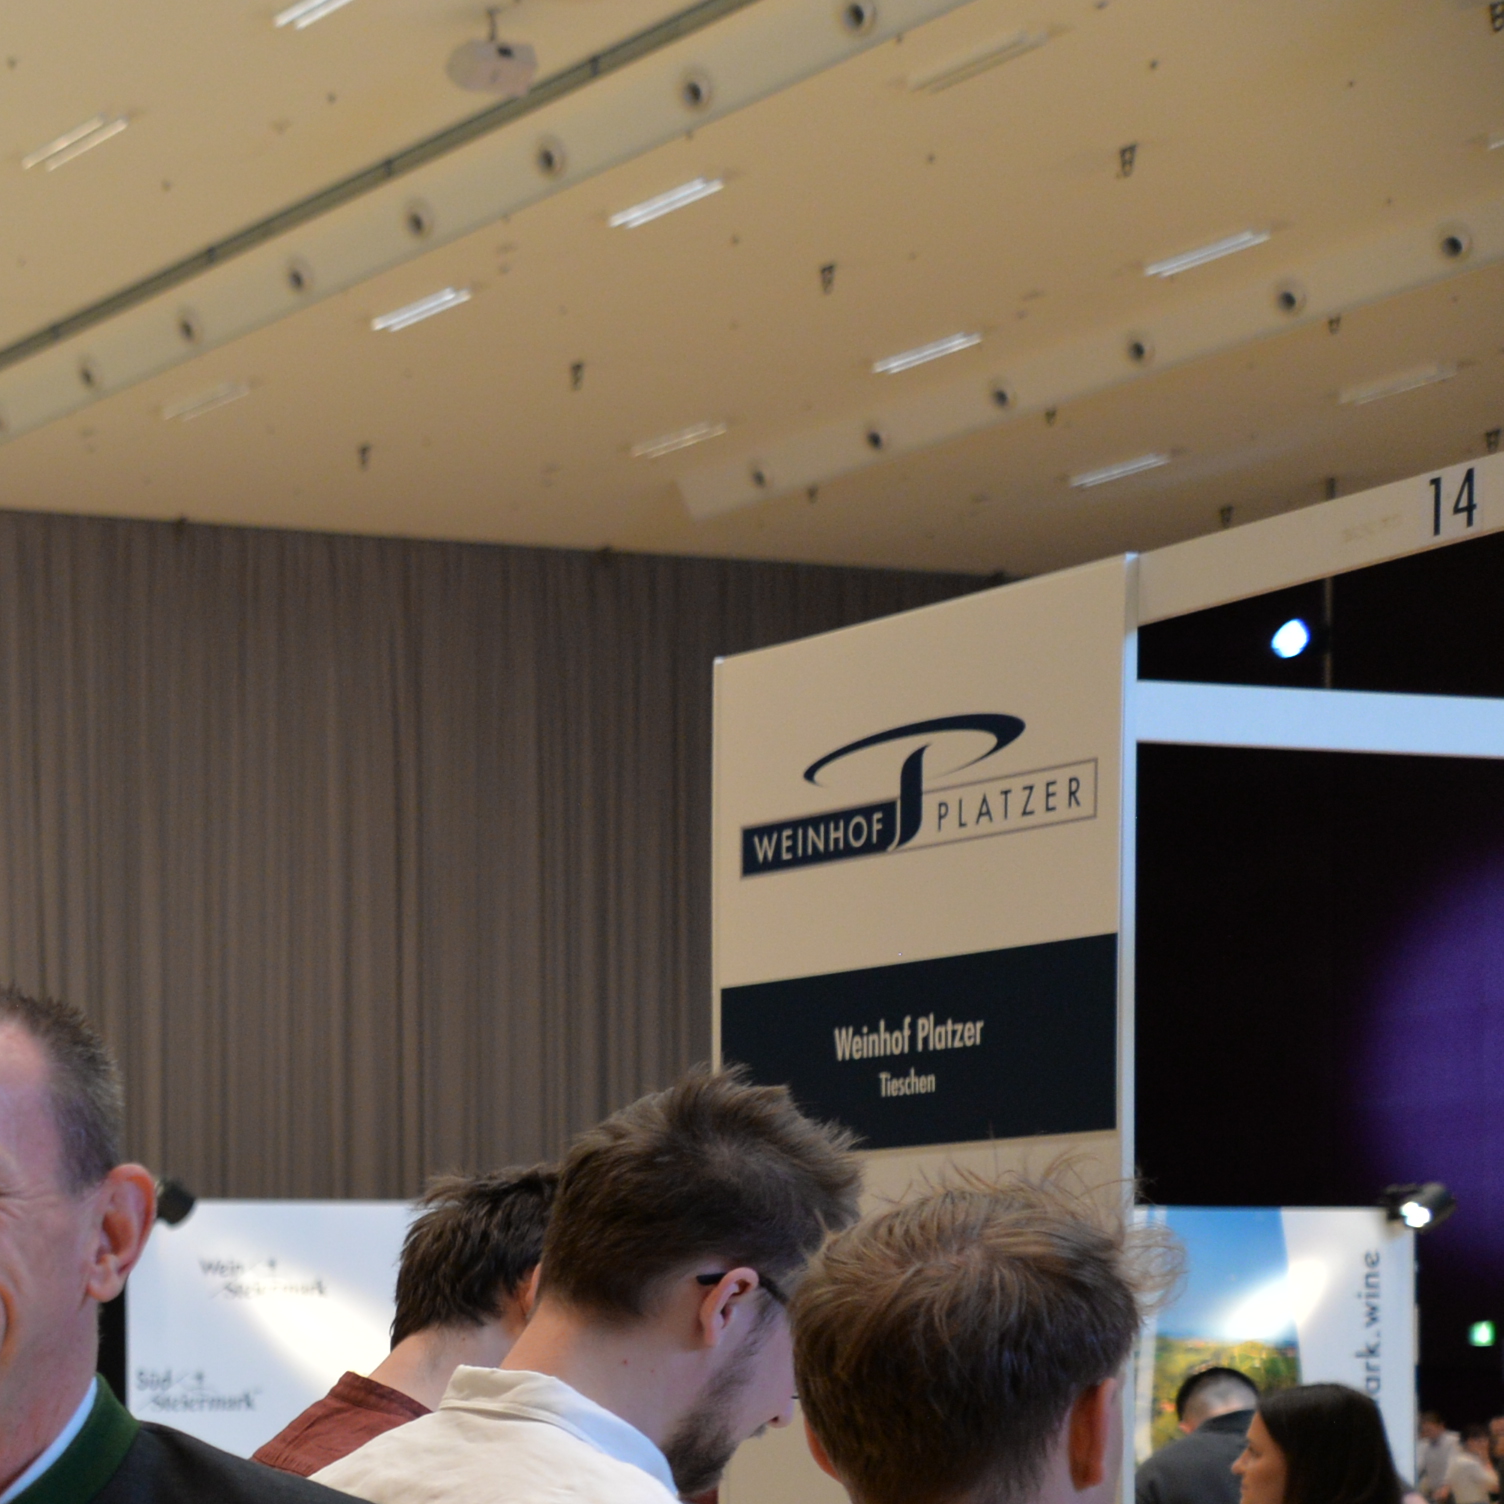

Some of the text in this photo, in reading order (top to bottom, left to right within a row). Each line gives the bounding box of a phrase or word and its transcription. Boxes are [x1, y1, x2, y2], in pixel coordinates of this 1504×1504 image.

[1430, 467, 1477, 536] 14
[753, 777, 1081, 864] WEINHOF PLATZER
[834, 1012, 984, 1061] Weinhof Platzer
[879, 1067, 936, 1097] Tieschen
